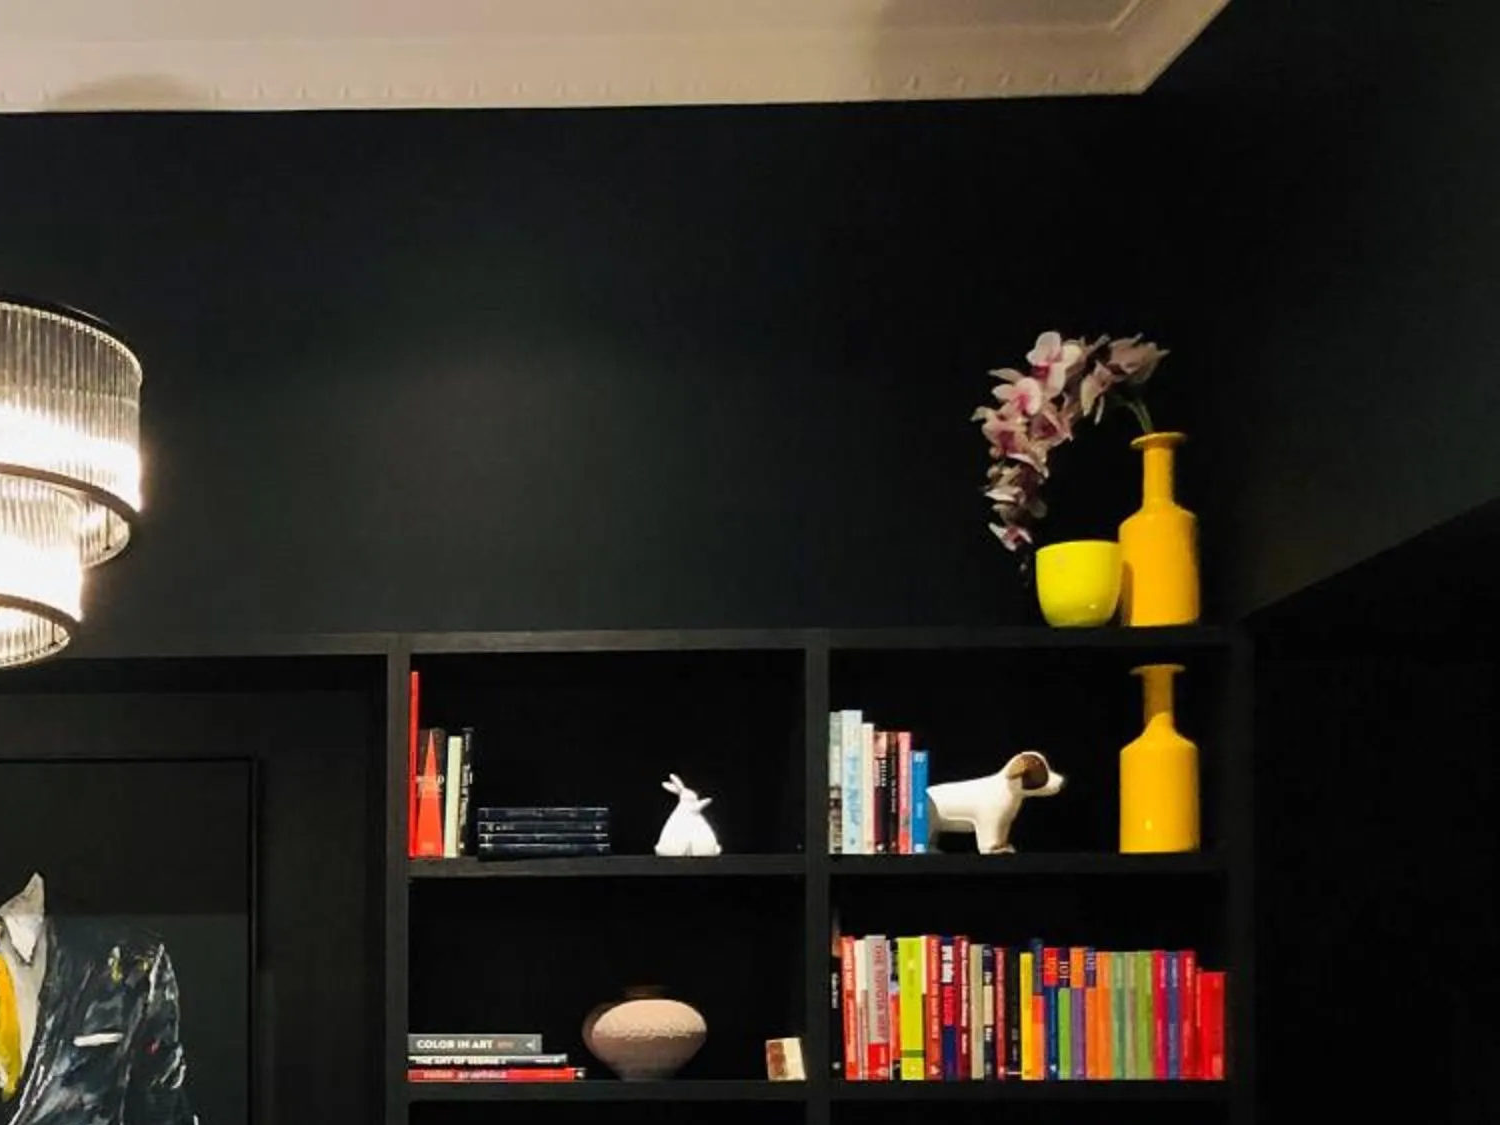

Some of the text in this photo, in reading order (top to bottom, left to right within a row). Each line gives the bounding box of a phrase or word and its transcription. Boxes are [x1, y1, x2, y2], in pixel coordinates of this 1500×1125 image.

[416, 1039, 493, 1049] COLOR IN ART
